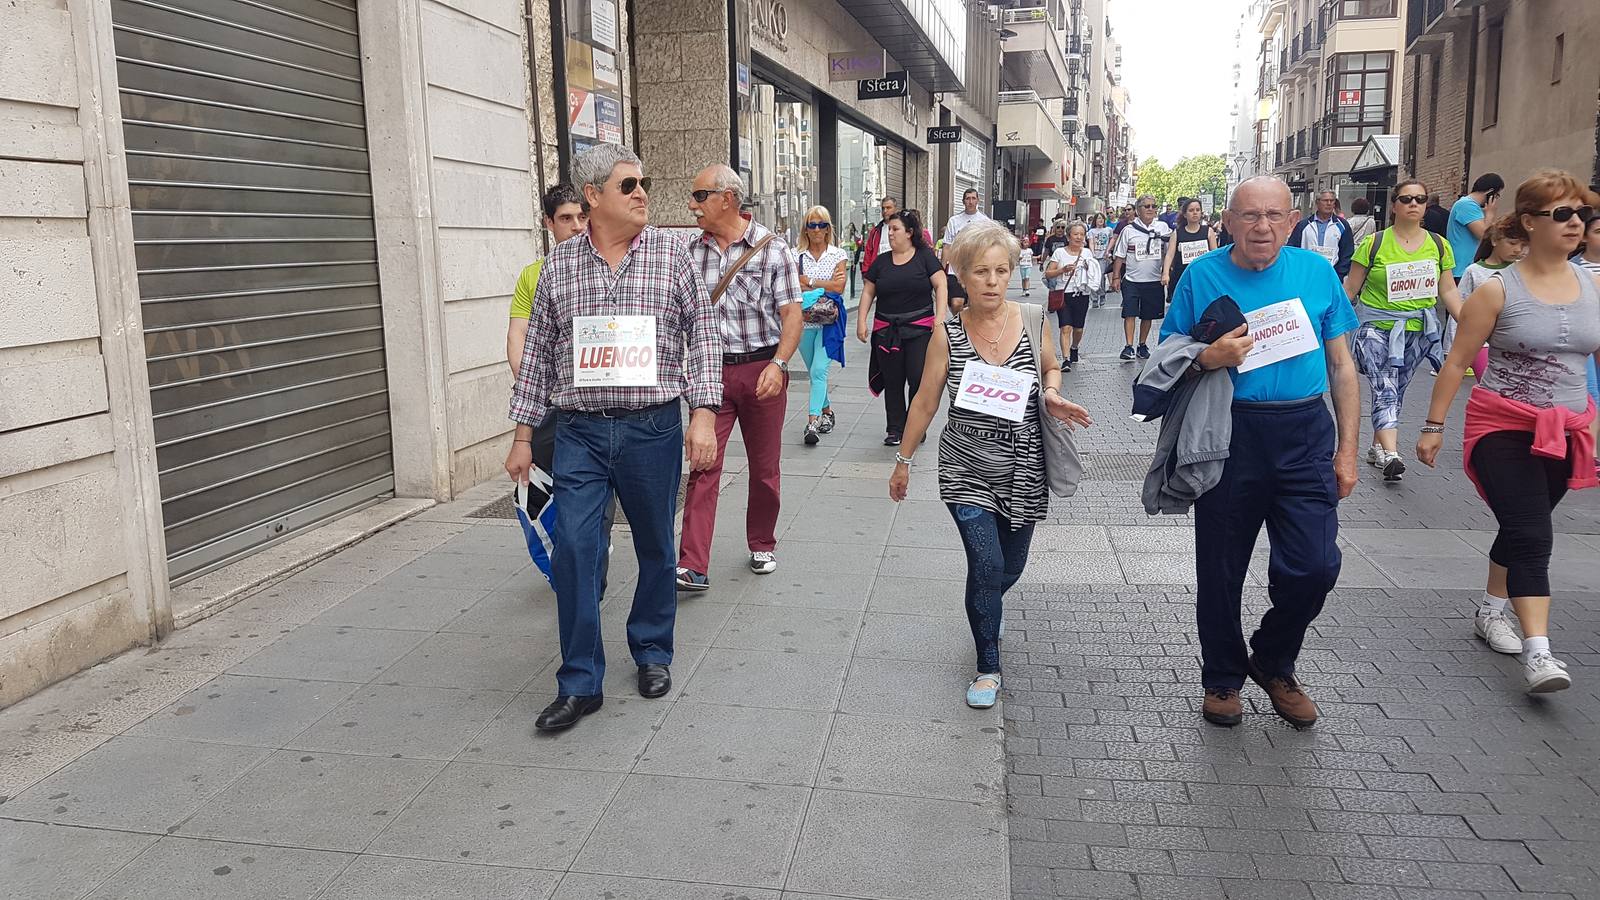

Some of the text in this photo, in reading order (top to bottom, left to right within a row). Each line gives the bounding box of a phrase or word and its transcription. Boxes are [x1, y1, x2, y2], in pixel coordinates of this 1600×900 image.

[832, 57, 881, 71] KIKO
[1391, 279, 1417, 292] GIRON
[1285, 319, 1300, 332] GIL
[579, 345, 653, 369] LUENGO
[965, 383, 1021, 402] DUO
